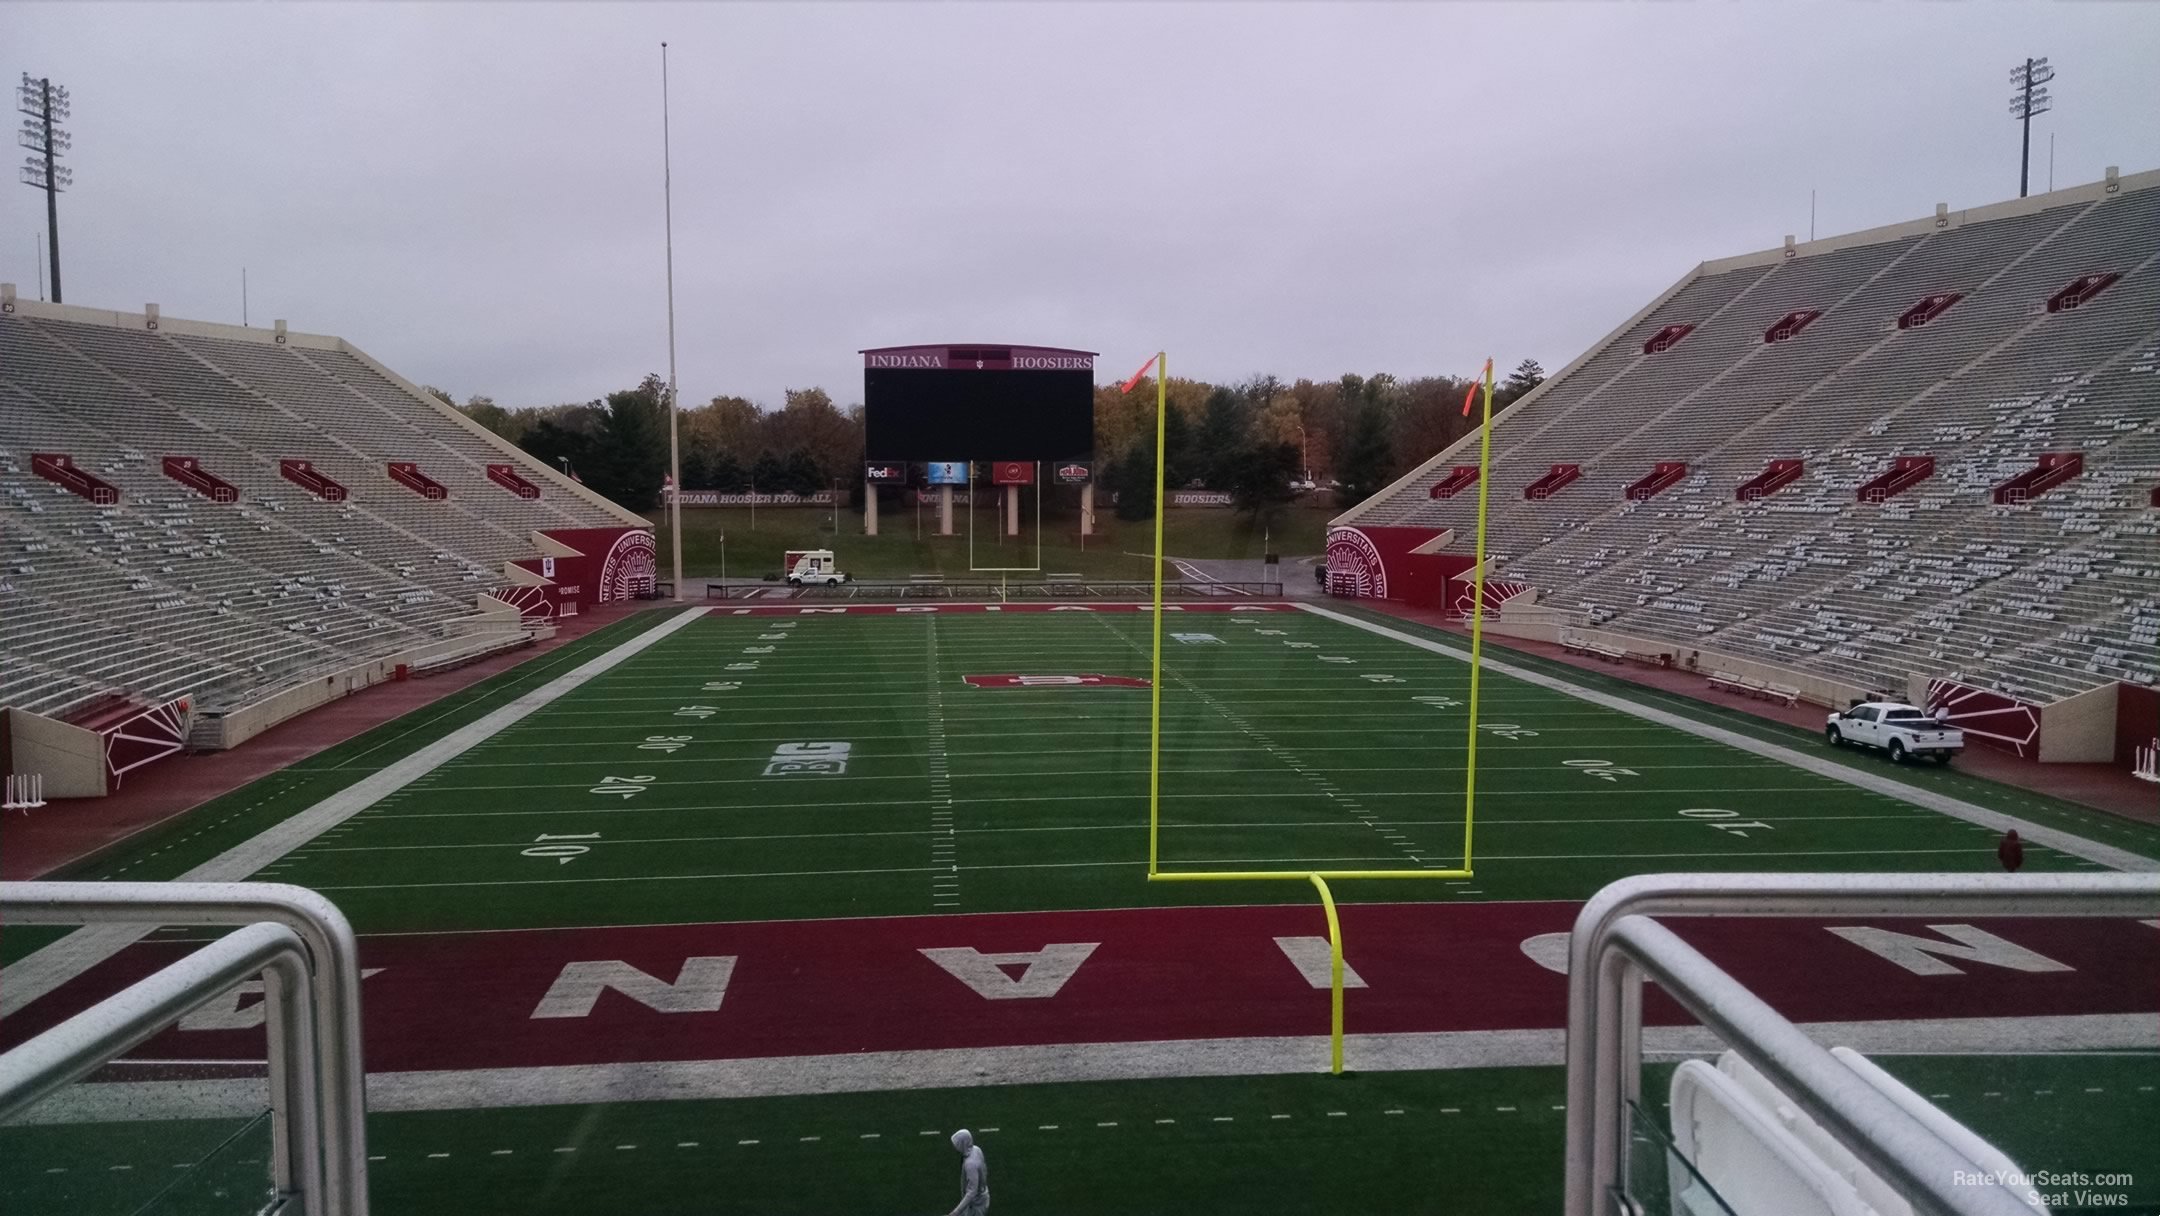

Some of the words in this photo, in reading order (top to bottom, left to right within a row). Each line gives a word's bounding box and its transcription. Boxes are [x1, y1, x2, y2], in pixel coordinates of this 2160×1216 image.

[871, 355, 942, 367] INDIANA
[1013, 357, 1092, 369] HOOSIERS
[183, 460, 192, 469] 29
[1905, 460, 1911, 468] 5
[2050, 457, 2056, 467] 6
[868, 467, 900, 478] FedEx
[667, 494, 718, 504] IDIANA
[720, 494, 771, 504] HOOSIER
[773, 494, 832, 504] FOOTALL
[1174, 494, 1232, 504] HOOSIERS
[733, 606, 1277, 615] INDIANA
[673, 705, 721, 716] 40
[1477, 723, 1541, 736] 30
[637, 735, 693, 750] 30
[1561, 759, 1641, 777] 20
[589, 775, 657, 794] 20
[1677, 808, 1776, 830] 10
[520, 831, 602, 857] 10
